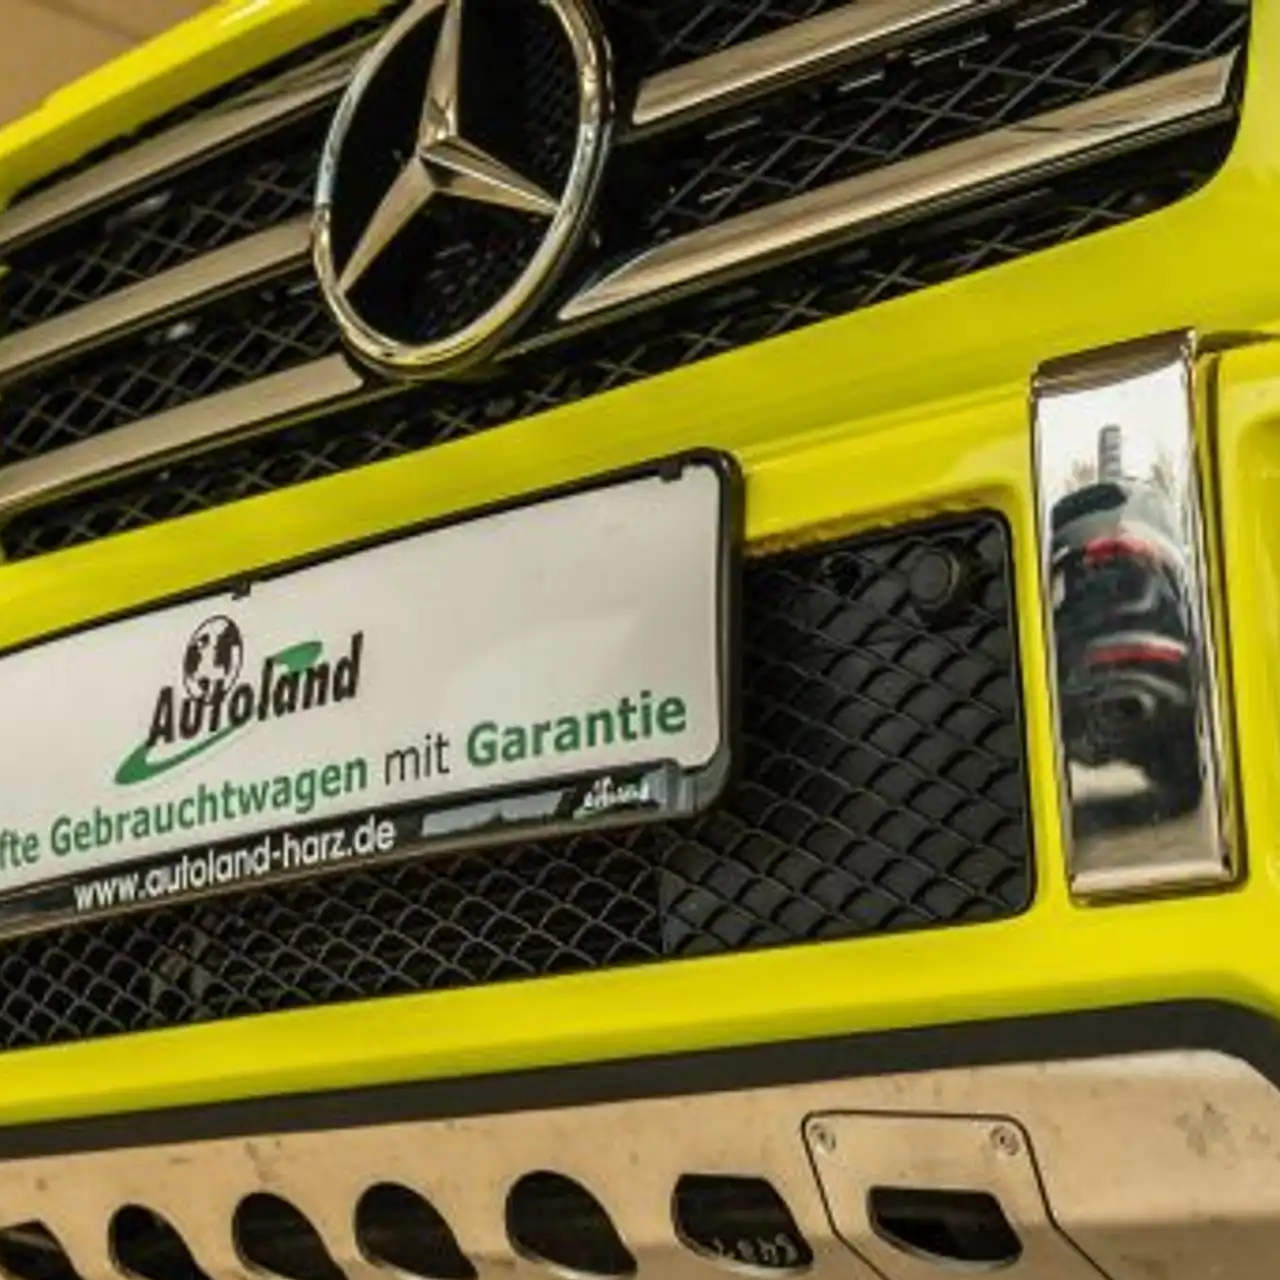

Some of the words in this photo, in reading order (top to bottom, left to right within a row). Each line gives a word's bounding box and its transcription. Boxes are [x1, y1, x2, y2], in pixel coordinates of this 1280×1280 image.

[145, 630, 363, 747] Autoland
[50, 757, 368, 857] Gebrauchtwagen
[385, 733, 450, 786] mit
[467, 690, 687, 767] Garantie
[73, 814, 396, 910] www.autoland-harz.de
